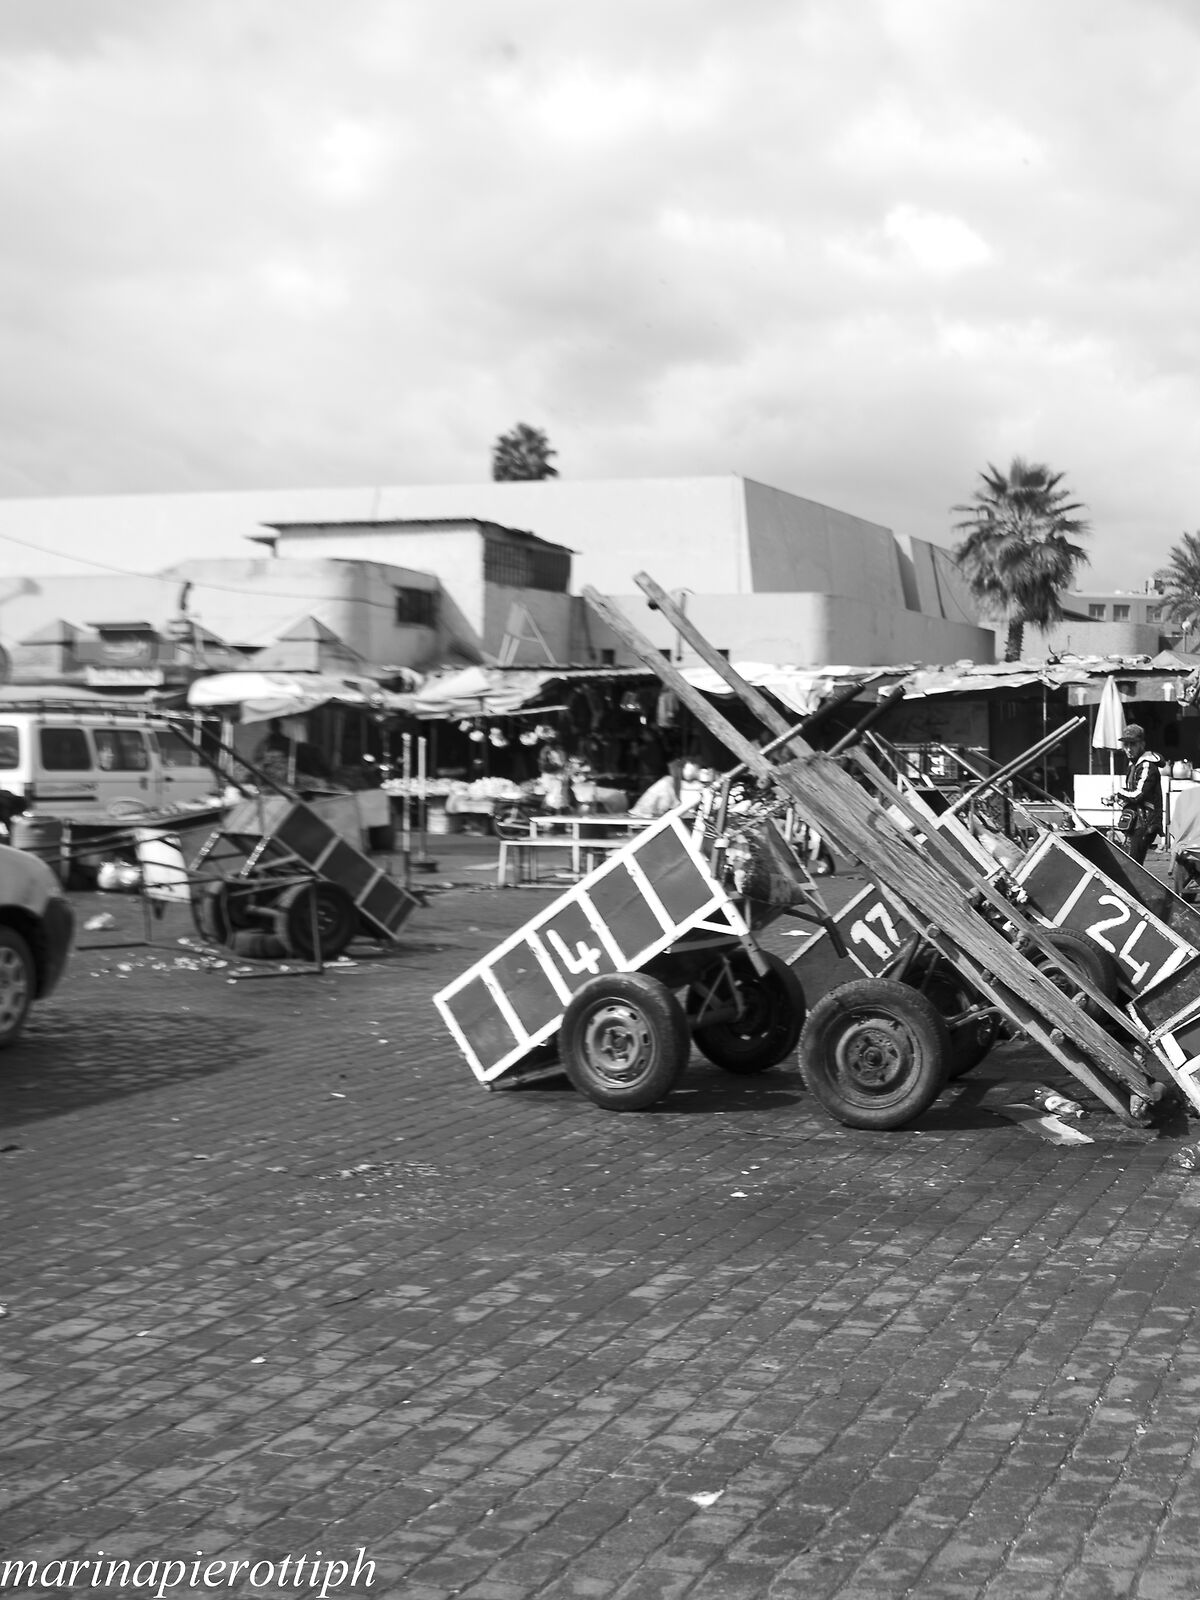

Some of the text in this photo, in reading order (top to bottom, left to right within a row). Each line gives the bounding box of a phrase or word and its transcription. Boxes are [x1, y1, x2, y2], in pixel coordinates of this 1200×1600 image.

[546, 929, 601, 974] 4
[850, 902, 902, 961] 17
[1085, 895, 1151, 985] 24
